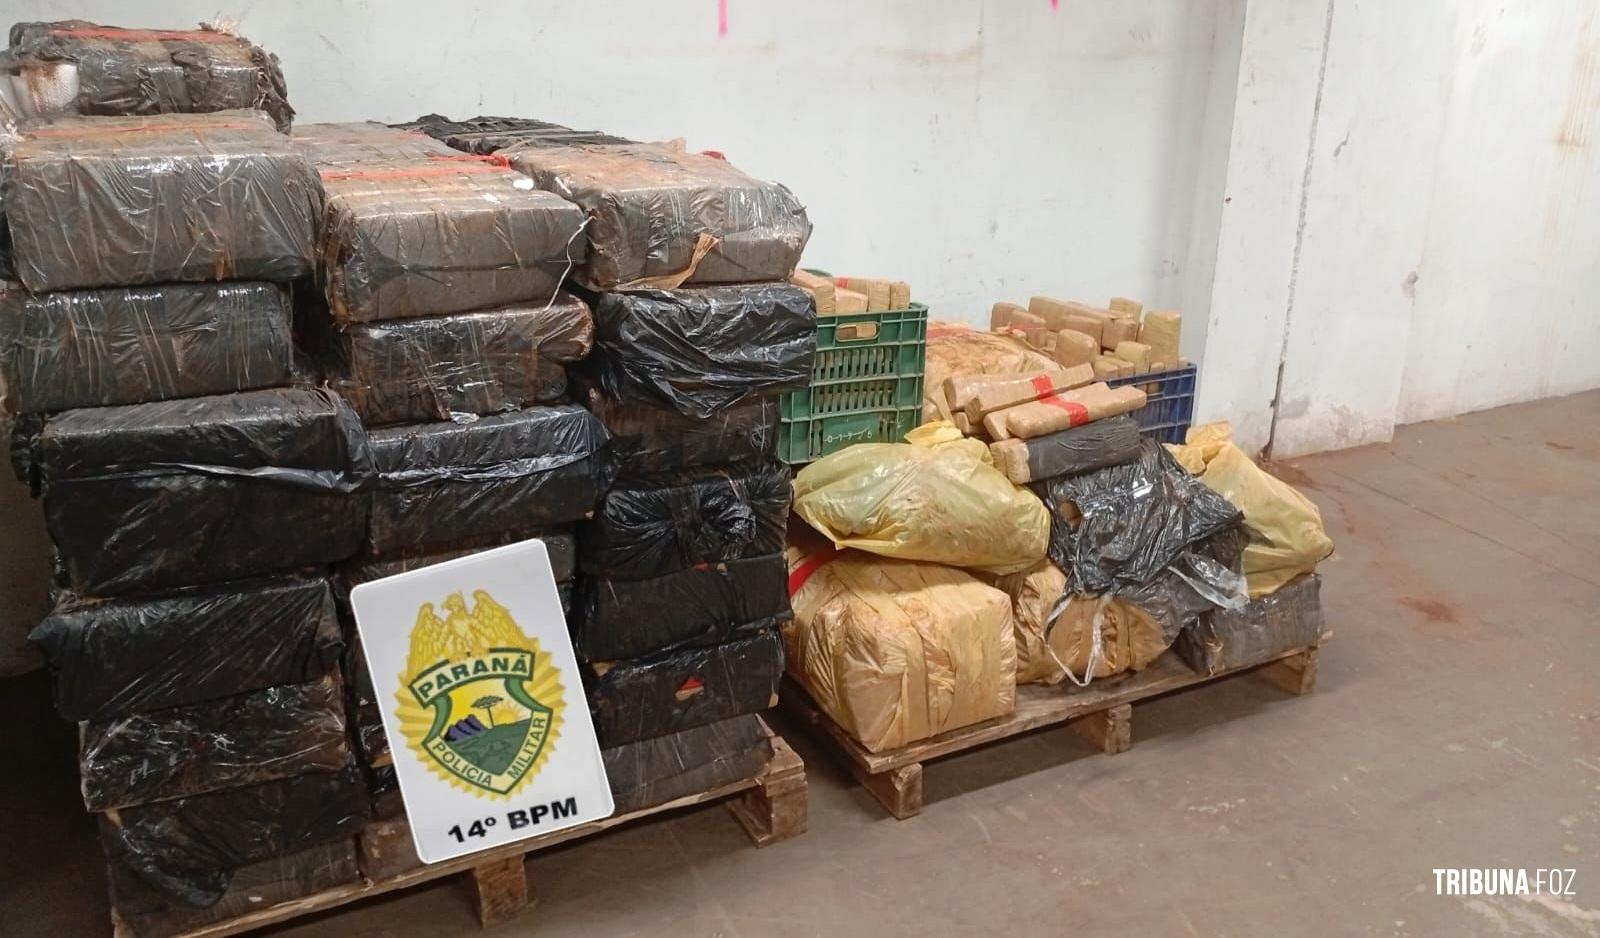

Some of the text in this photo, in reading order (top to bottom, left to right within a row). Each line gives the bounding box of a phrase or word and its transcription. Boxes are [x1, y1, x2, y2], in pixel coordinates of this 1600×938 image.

[418, 654, 528, 699] PARANÁ
[432, 717, 546, 786] POLICIA MILITAR
[507, 797, 578, 830] BPM
